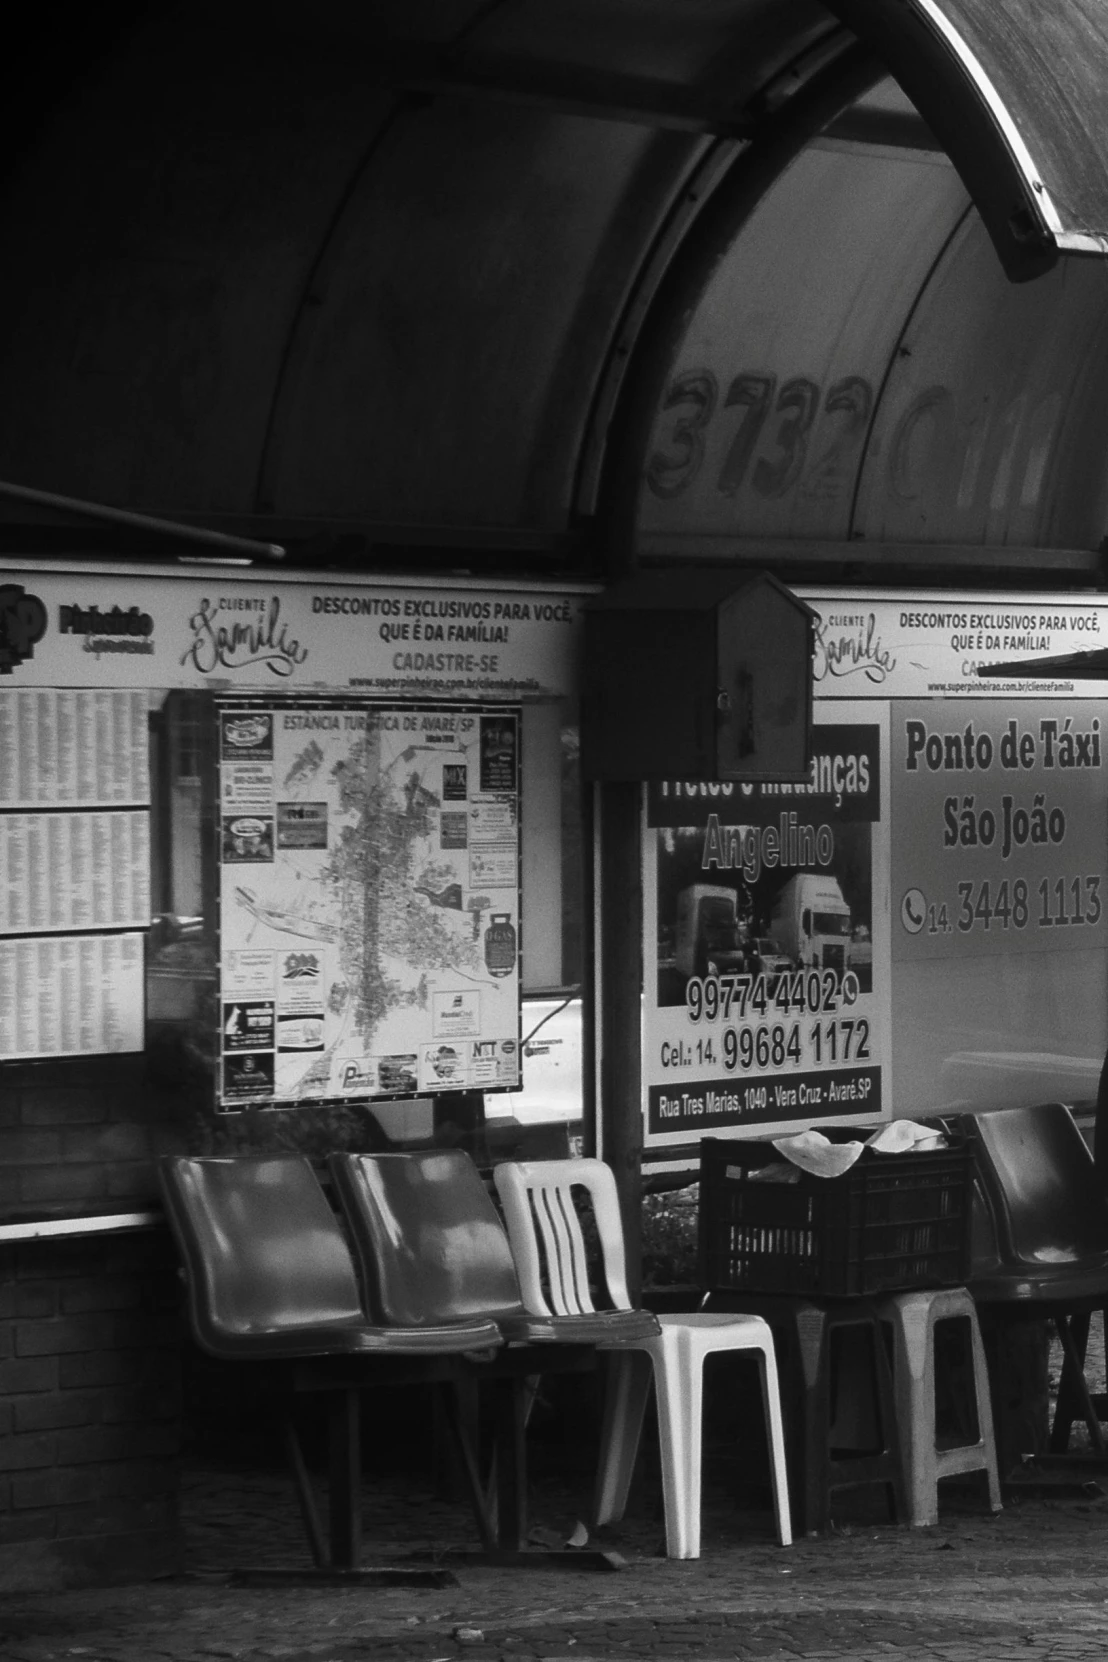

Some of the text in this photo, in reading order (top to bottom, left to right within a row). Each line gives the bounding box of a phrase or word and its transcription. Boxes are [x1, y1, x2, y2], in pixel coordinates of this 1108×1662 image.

[219, 598, 266, 612] CLIENTE
[312, 595, 572, 624] DESCONTOS EXCLUSIVOS PARA VOCÊ,
[379, 618, 508, 643] QUE É DA FAMÍLIA!
[828, 615, 865, 627] CLIENTE
[899, 611, 1101, 634] DESCONTOS EXCLUSIVOS PARA VOCÊ,
[950, 631, 1051, 653] QUE É DA FAMÍLIA!
[392, 651, 499, 673] CADASTRE-SE
[927, 682, 1075, 693] www.superpinheirao.com.br/clientefamilia
[402, 716, 417, 732] DE
[905, 717, 1101, 771] Ponto de Táxi
[943, 793, 1066, 860] São João
[701, 811, 834, 883] Angelino
[928, 875, 1101, 933] 14. 3448 1113
[687, 970, 837, 1023] 99774 4402
[660, 1018, 870, 1070] Cel.: 14. 99684 1172
[659, 1095, 680, 1118] Rua
[682, 1093, 704, 1115] Tres
[706, 1090, 742, 1114] Marias,
[743, 1086, 767, 1109] 1040
[775, 1084, 797, 1107] Vera
[799, 1082, 821, 1104] Cruz
